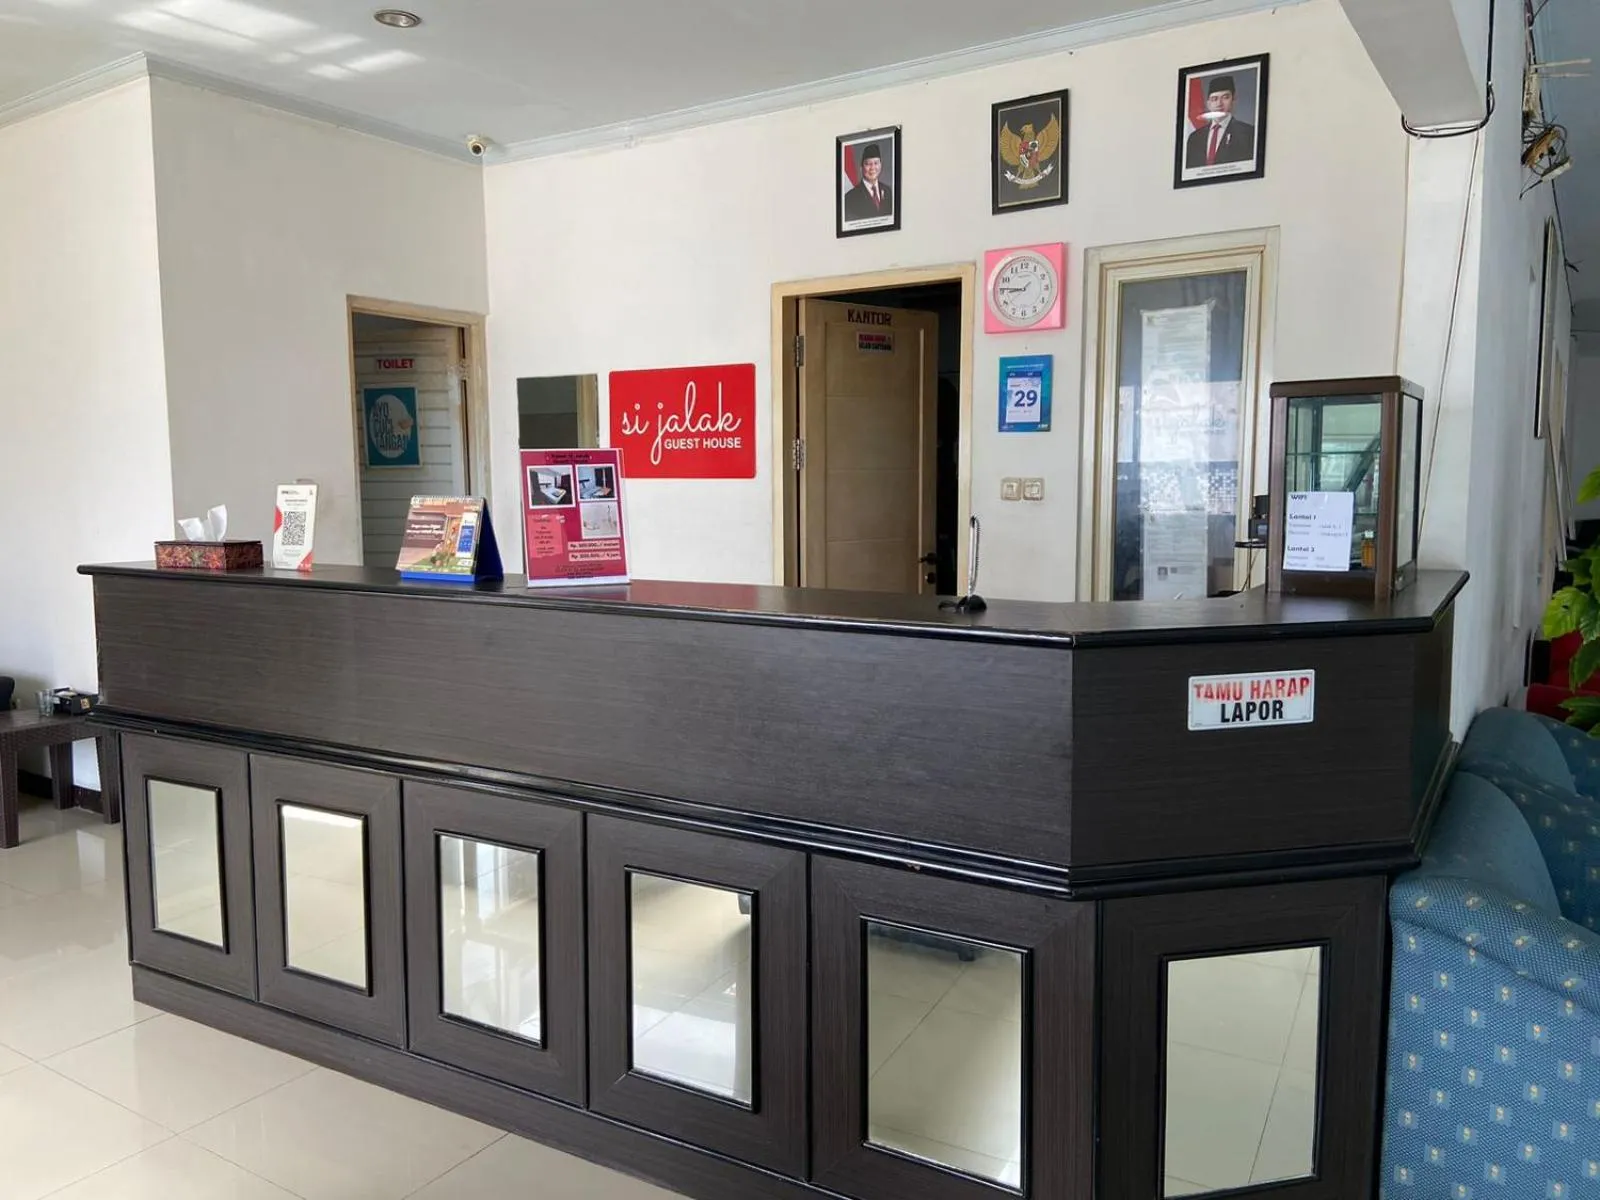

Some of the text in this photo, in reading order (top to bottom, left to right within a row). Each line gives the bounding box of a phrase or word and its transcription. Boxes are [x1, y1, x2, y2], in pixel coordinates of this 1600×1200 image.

[848, 309, 892, 326] KANTOR
[377, 358, 415, 369] TOILET
[1014, 389, 1038, 408] 29
[621, 381, 742, 466] si jalak
[664, 436, 742, 450] GUEST HOUSE
[1193, 677, 1310, 701] TAMU HARAP
[1220, 700, 1284, 723] LAPOR
